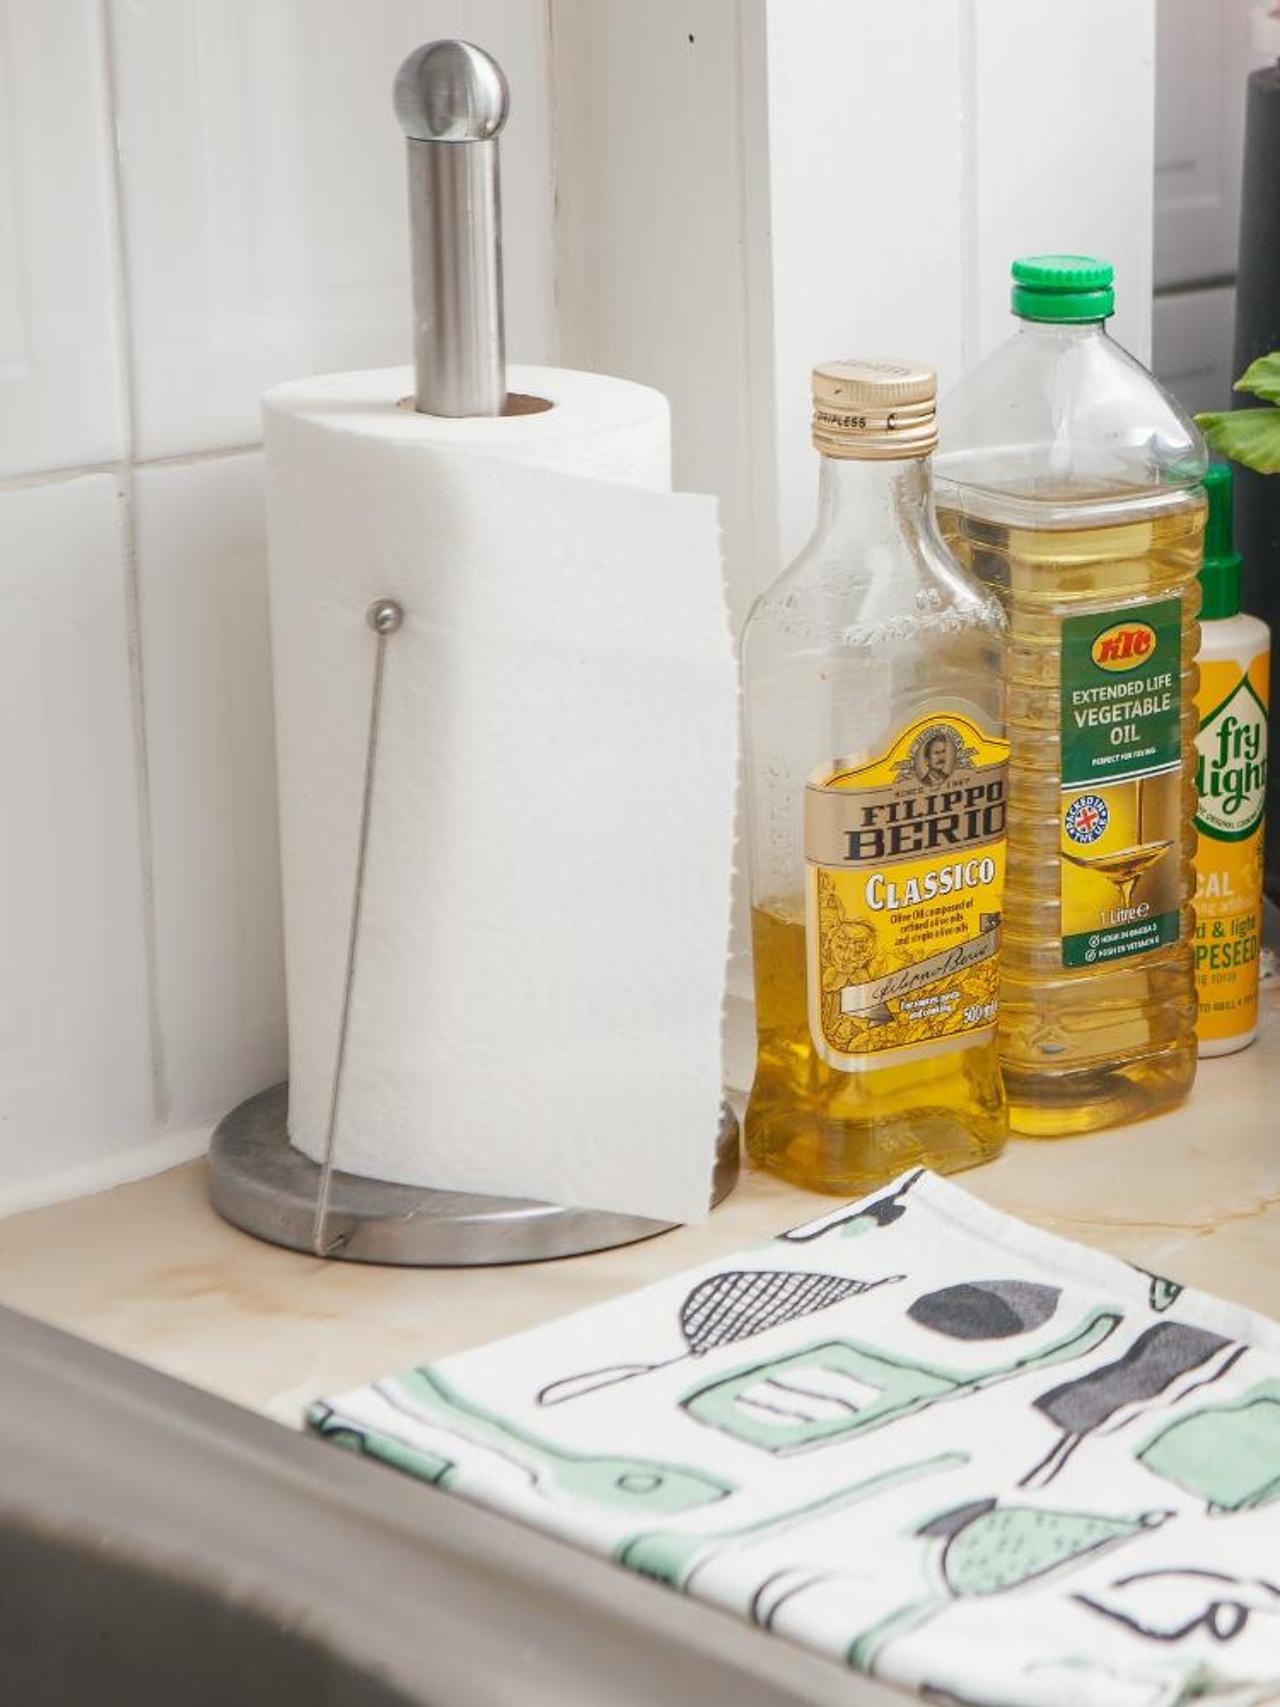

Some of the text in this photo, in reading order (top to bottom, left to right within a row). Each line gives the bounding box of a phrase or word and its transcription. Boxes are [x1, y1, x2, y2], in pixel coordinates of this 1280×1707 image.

[1072, 673, 1172, 706] EXTENDED LIFE
[1073, 692, 1171, 728] VEGETABLE
[1110, 723, 1140, 745] OIL
[1216, 716, 1260, 768] fry
[860, 780, 1004, 827] FILIPPO
[1065, 796, 1094, 830] PACKED
[843, 800, 1006, 861] BERIO
[865, 857, 996, 912] CLASSICO
[1110, 907, 1136, 925] Litre
[1195, 935, 1258, 971] PESEED
